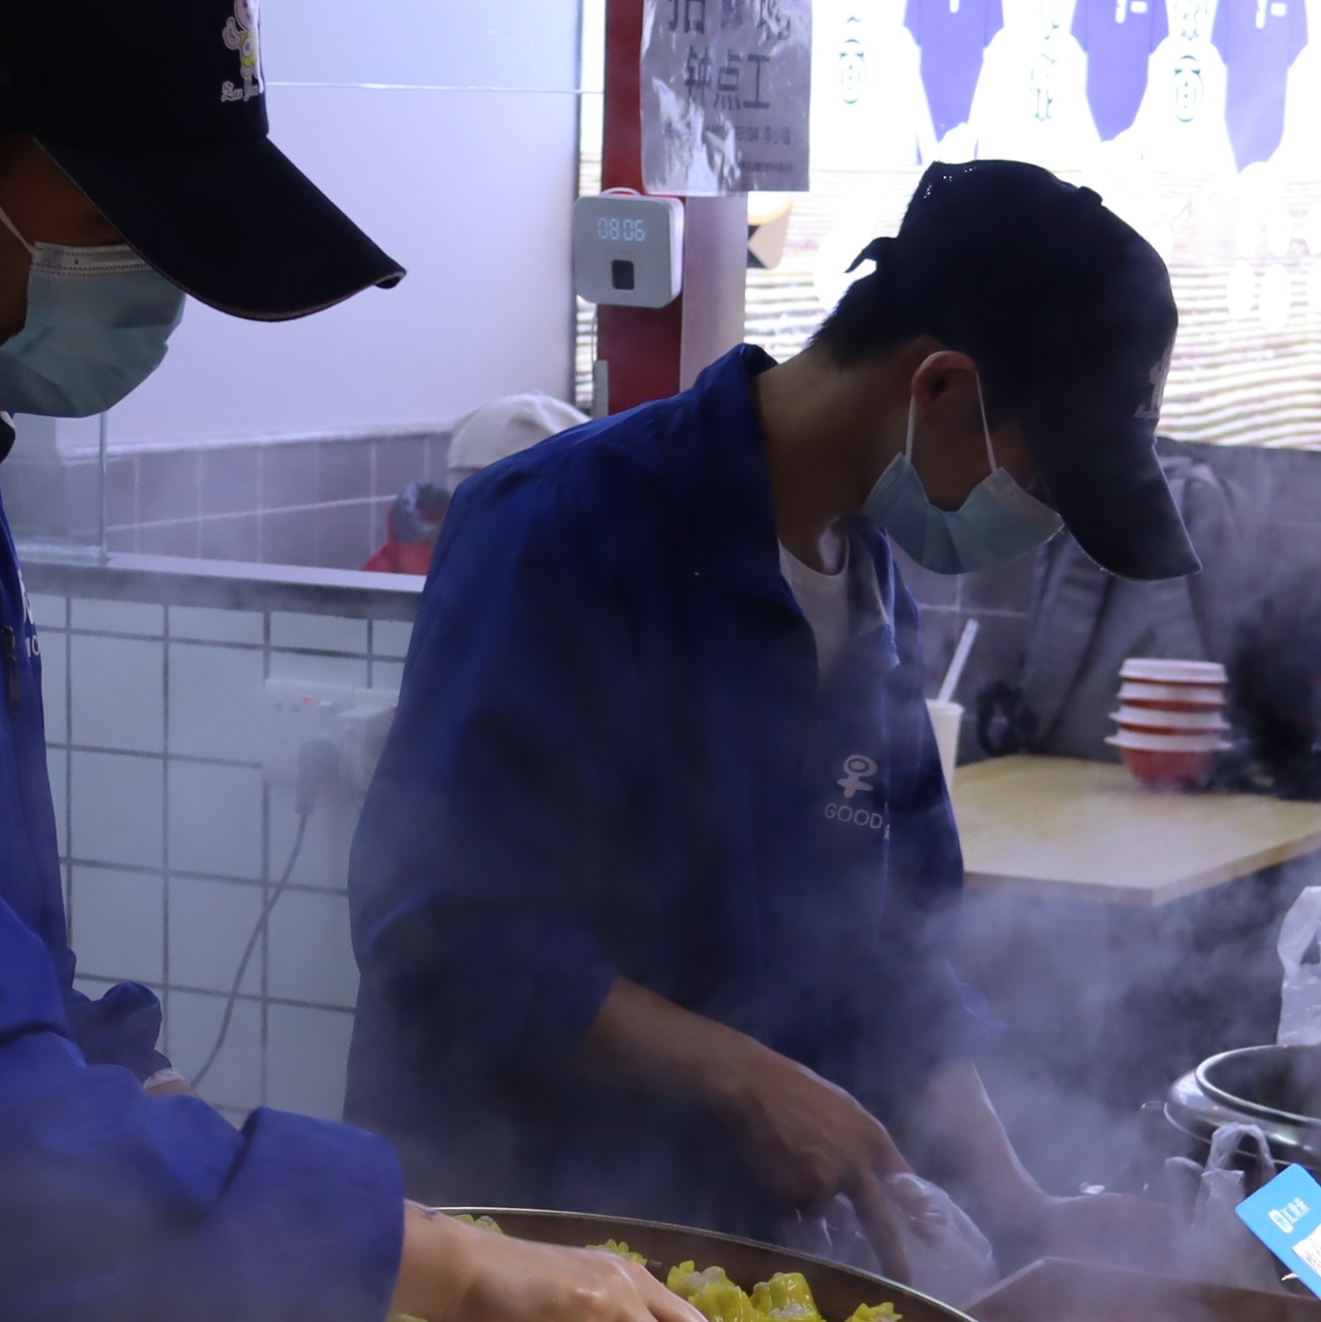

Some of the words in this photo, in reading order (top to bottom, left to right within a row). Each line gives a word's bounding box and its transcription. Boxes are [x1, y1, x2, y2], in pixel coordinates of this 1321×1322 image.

[685, 46, 770, 111] 钟点工
[824, 802, 884, 830] GOOD
